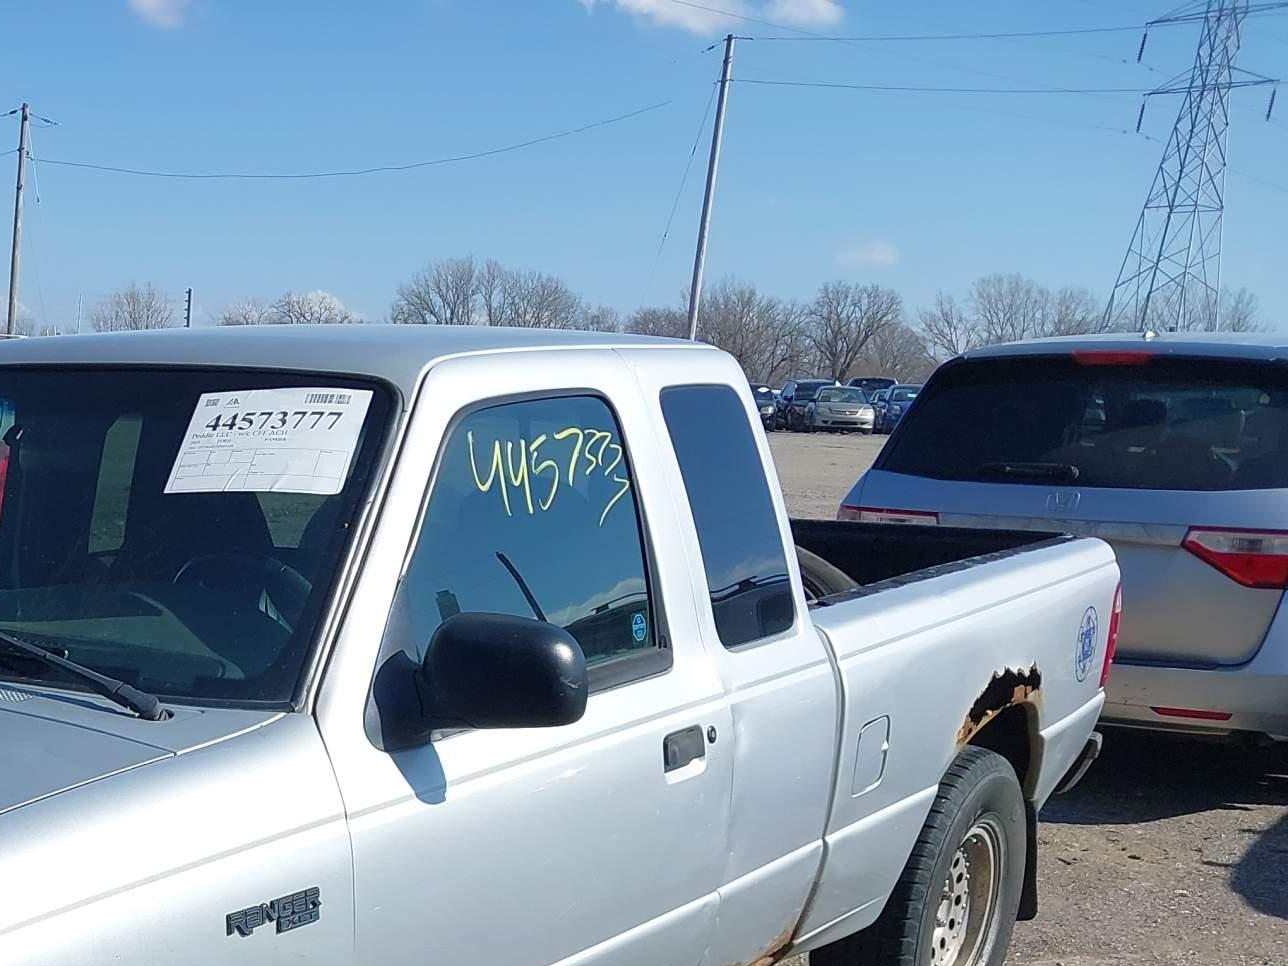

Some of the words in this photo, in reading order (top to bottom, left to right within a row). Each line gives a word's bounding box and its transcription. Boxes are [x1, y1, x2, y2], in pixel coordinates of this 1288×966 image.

[205, 411, 345, 431] 44573777
[226, 886, 322, 937] RANGER
[278, 911, 320, 932] XLT
